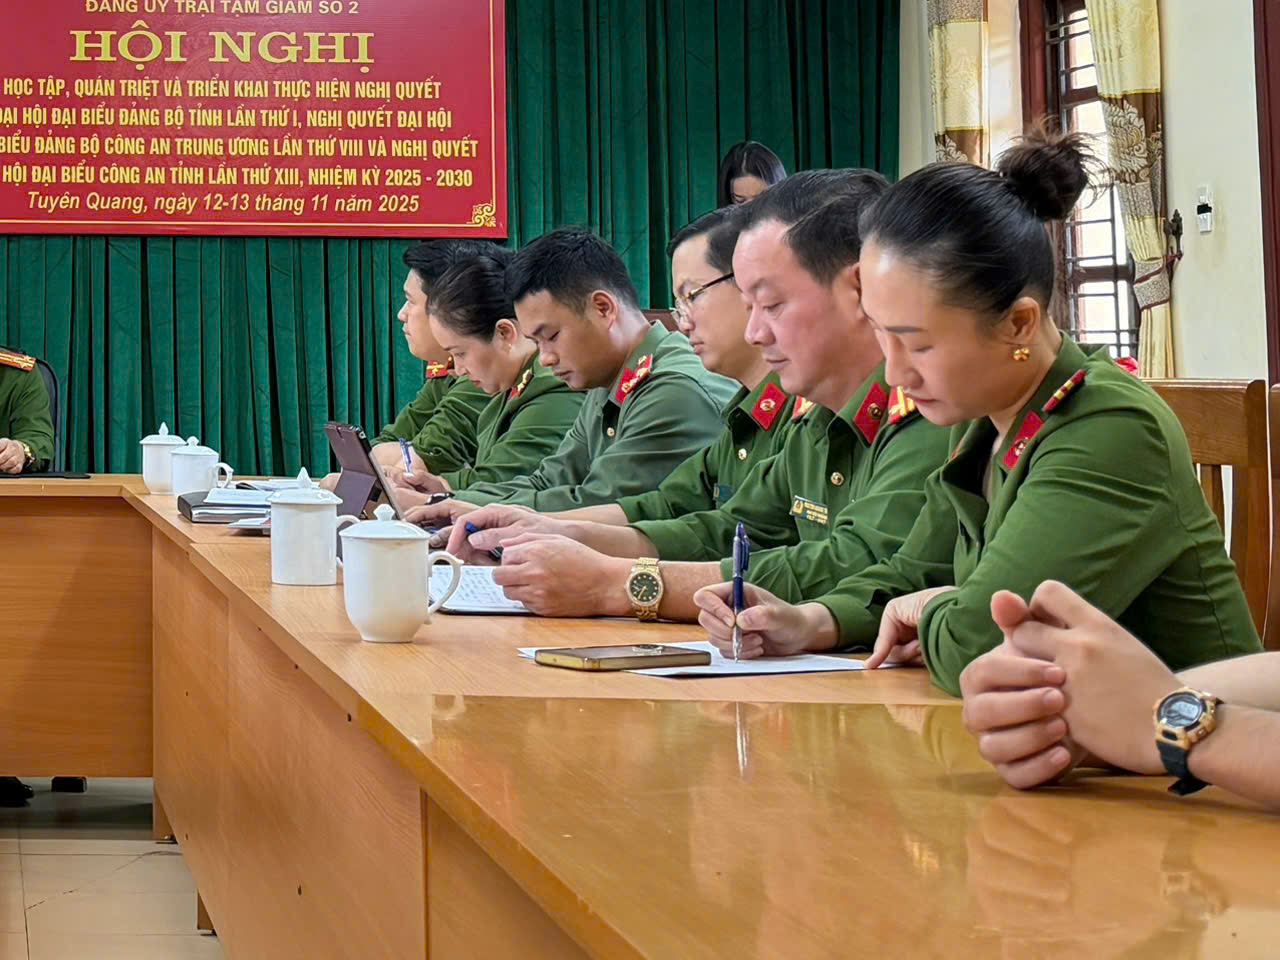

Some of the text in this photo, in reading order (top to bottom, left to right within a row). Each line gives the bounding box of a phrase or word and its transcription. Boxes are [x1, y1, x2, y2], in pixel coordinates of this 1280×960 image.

[175, 0, 215, 17] TRẠI
[220, 0, 259, 17] TẠM
[266, 0, 312, 14] GIAM
[349, 1, 359, 14] 2
[69, 20, 374, 74] HỘI NGHỊ
[3, 74, 441, 102] HỌC TẬP, QUÁN TRIỆT VÀ TRIỂN KHAI THỰC HIỆN NGHỊ QUYẾT
[22, 104, 47, 128] HỘI
[51, 108, 76, 128] ĐẠI
[81, 101, 114, 125] BIỂU
[119, 101, 160, 126] ĐẢNG
[164, 105, 184, 129] BỘ
[189, 103, 223, 126] TỈNH
[227, 103, 255, 127] LẦN
[260, 105, 289, 127] THỨ
[293, 111, 302, 129] I,
[307, 110, 342, 131] NGHỊ
[347, 105, 393, 129] QUYẾT
[397, 110, 421, 131] ĐẠI
[427, 108, 452, 132] HỘI
[35, 129, 75, 154] ĐẢNG
[80, 134, 100, 157] BỘ
[104, 134, 145, 155] CÔNG
[150, 138, 170, 155] AN
[175, 138, 223, 156] TRUNG
[228, 138, 269, 156] ƯƠNG
[274, 133, 302, 156] LẦN
[307, 134, 336, 156] THỨ
[339, 139, 364, 156] VIII
[368, 134, 387, 157] VÀ
[391, 140, 428, 160] NGHỊ
[432, 134, 478, 158] QUYẾT
[2, 162, 27, 186] HỘI
[31, 165, 56, 187] ĐẠI
[61, 159, 94, 183] BIỂU
[99, 163, 140, 184] CÔNG
[145, 167, 165, 184] AN
[170, 161, 204, 184] TỈNH
[209, 162, 237, 185] LẦN
[242, 163, 271, 185] THỨ
[274, 168, 304, 187] XIII,
[308, 166, 357, 189] NHIỆM
[361, 165, 380, 186] KỲ
[385, 169, 421, 186] 2025
[436, 169, 473, 187] 2030
[28, 191, 420, 216] Tuyên Quang, ngày 12-13 tháng 11 năm 2025
